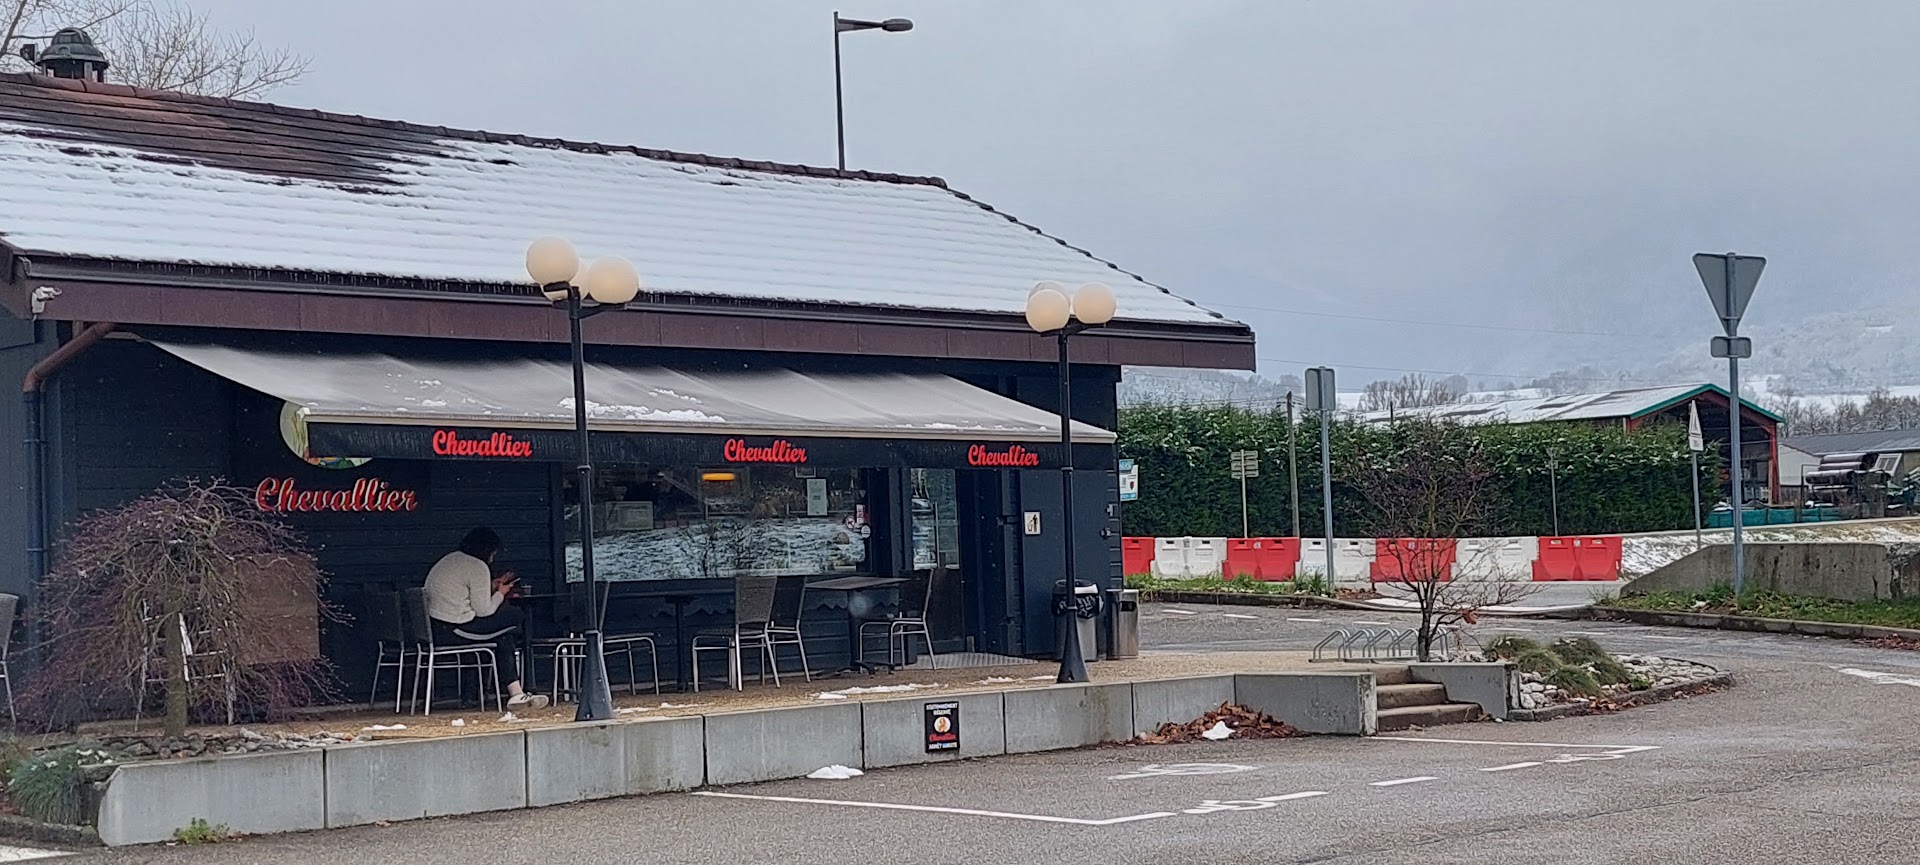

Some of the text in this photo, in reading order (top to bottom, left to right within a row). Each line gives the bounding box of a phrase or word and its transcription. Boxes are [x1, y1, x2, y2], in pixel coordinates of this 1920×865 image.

[432, 429, 532, 458] Chevallier
[724, 438, 807, 462] Chevallier
[968, 444, 1040, 466] Chevallier
[255, 476, 418, 512] Chevallier
